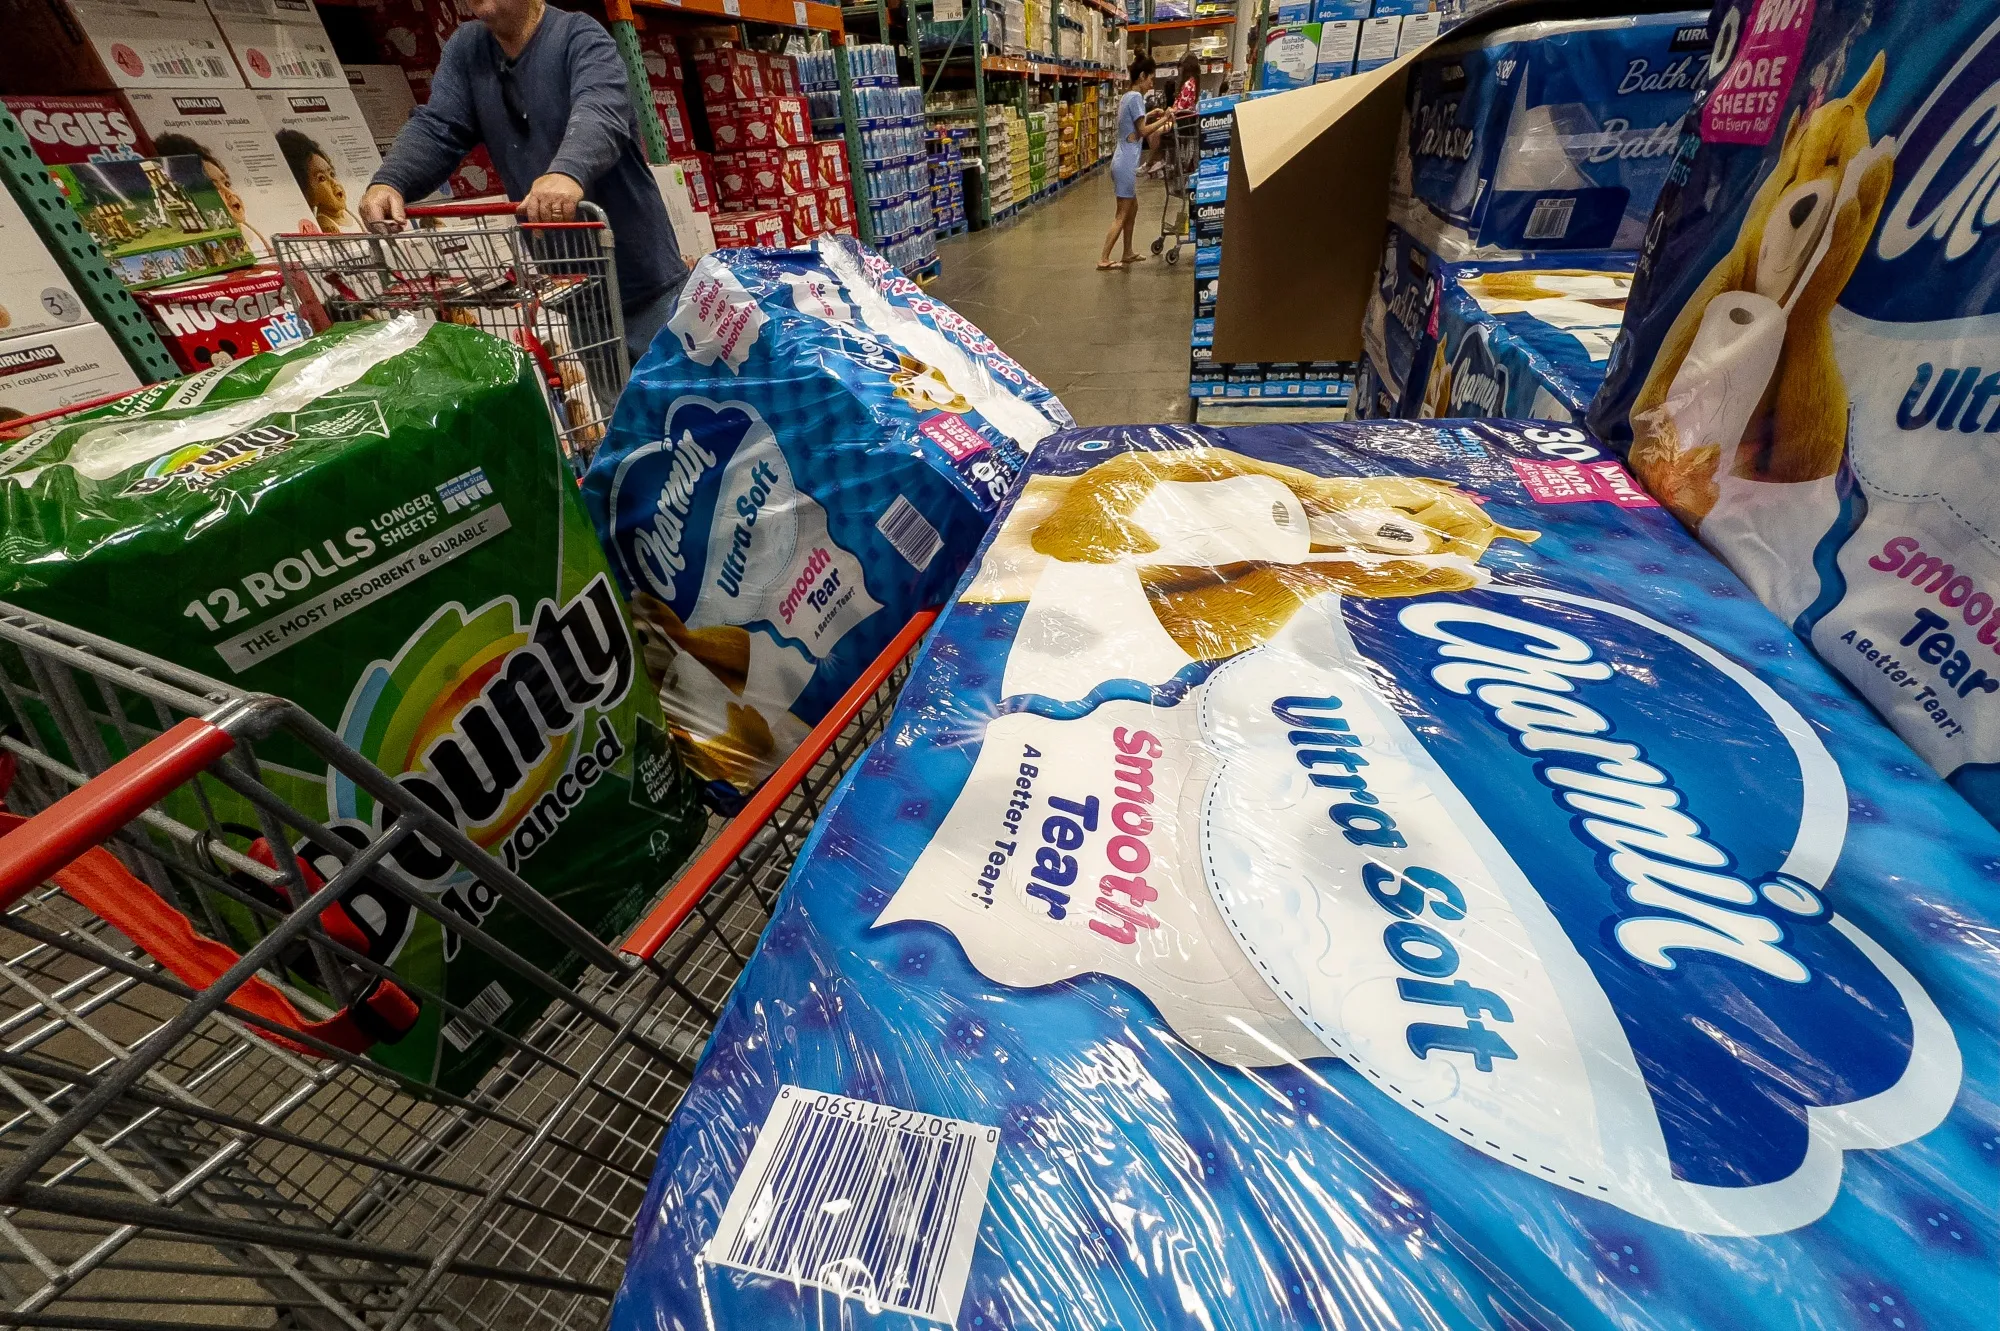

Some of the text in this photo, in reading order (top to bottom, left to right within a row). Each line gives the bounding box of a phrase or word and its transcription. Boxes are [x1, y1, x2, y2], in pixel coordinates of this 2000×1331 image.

[1318, 11, 1331, 19] 640
[1376, 6, 1390, 14] 640
[116, 51, 128, 68] 4
[250, 54, 260, 69] 4
[1617, 55, 1692, 95] Bath
[177, 97, 221, 109] KIRKLAND
[292, 97, 326, 108] KIRKLAND
[1711, 91, 1779, 114] SHEETS
[164, 118, 191, 127] diapers
[195, 118, 222, 126] couches
[281, 117, 302, 125] diapers
[1711, 117, 1724, 131] On
[1725, 118, 1751, 134] Every
[1589, 118, 1686, 163] Bath
[714, 224, 738, 232] HUGGIES
[755, 216, 783, 235] HUGGIES
[199, 290, 226, 300] EDITION
[229, 284, 256, 295] ÉDITION
[257, 279, 280, 290] LIMITÉE
[691, 280, 706, 303] OUR
[698, 278, 724, 323] softest
[1199, 290, 1209, 301] 10
[43, 296, 63, 316] 3
[716, 304, 738, 339] most
[721, 301, 757, 361] absorbent
[18, 373, 58, 386] couches
[63, 361, 100, 377] pañales
[17, 426, 57, 454] MOST
[925, 426, 964, 456] NEW!
[1523, 427, 1600, 461] 30
[371, 493, 434, 532] LONGER
[634, 428, 717, 601] Charmin
[716, 459, 779, 598] Ultra Soft
[183, 526, 377, 632] 12 ROLLS
[778, 545, 832, 625] Smooth
[806, 566, 842, 615] Tear
[240, 628, 278, 657] THE
[282, 603, 330, 637] MOST
[331, 558, 417, 613] ABSORBENT
[418, 552, 432, 566] &
[813, 629, 822, 641] A
[817, 608, 839, 636] Better
[1899, 606, 2000, 699] Tear
[1840, 629, 1965, 739] A Better Tear!
[290, 572, 635, 968] Bounty
[638, 753, 655, 774] The
[642, 747, 671, 784] Quicker
[646, 762, 672, 795] Picker
[650, 771, 676, 803] Upper
[1397, 601, 1826, 985] Charmin
[970, 743, 1042, 904] A Better Tear!
[1088, 725, 1164, 947] Smooth
[1026, 793, 1100, 921] Tear
[1271, 694, 1520, 1073] Ultra Soft
[986, 1129, 997, 1143] 0
